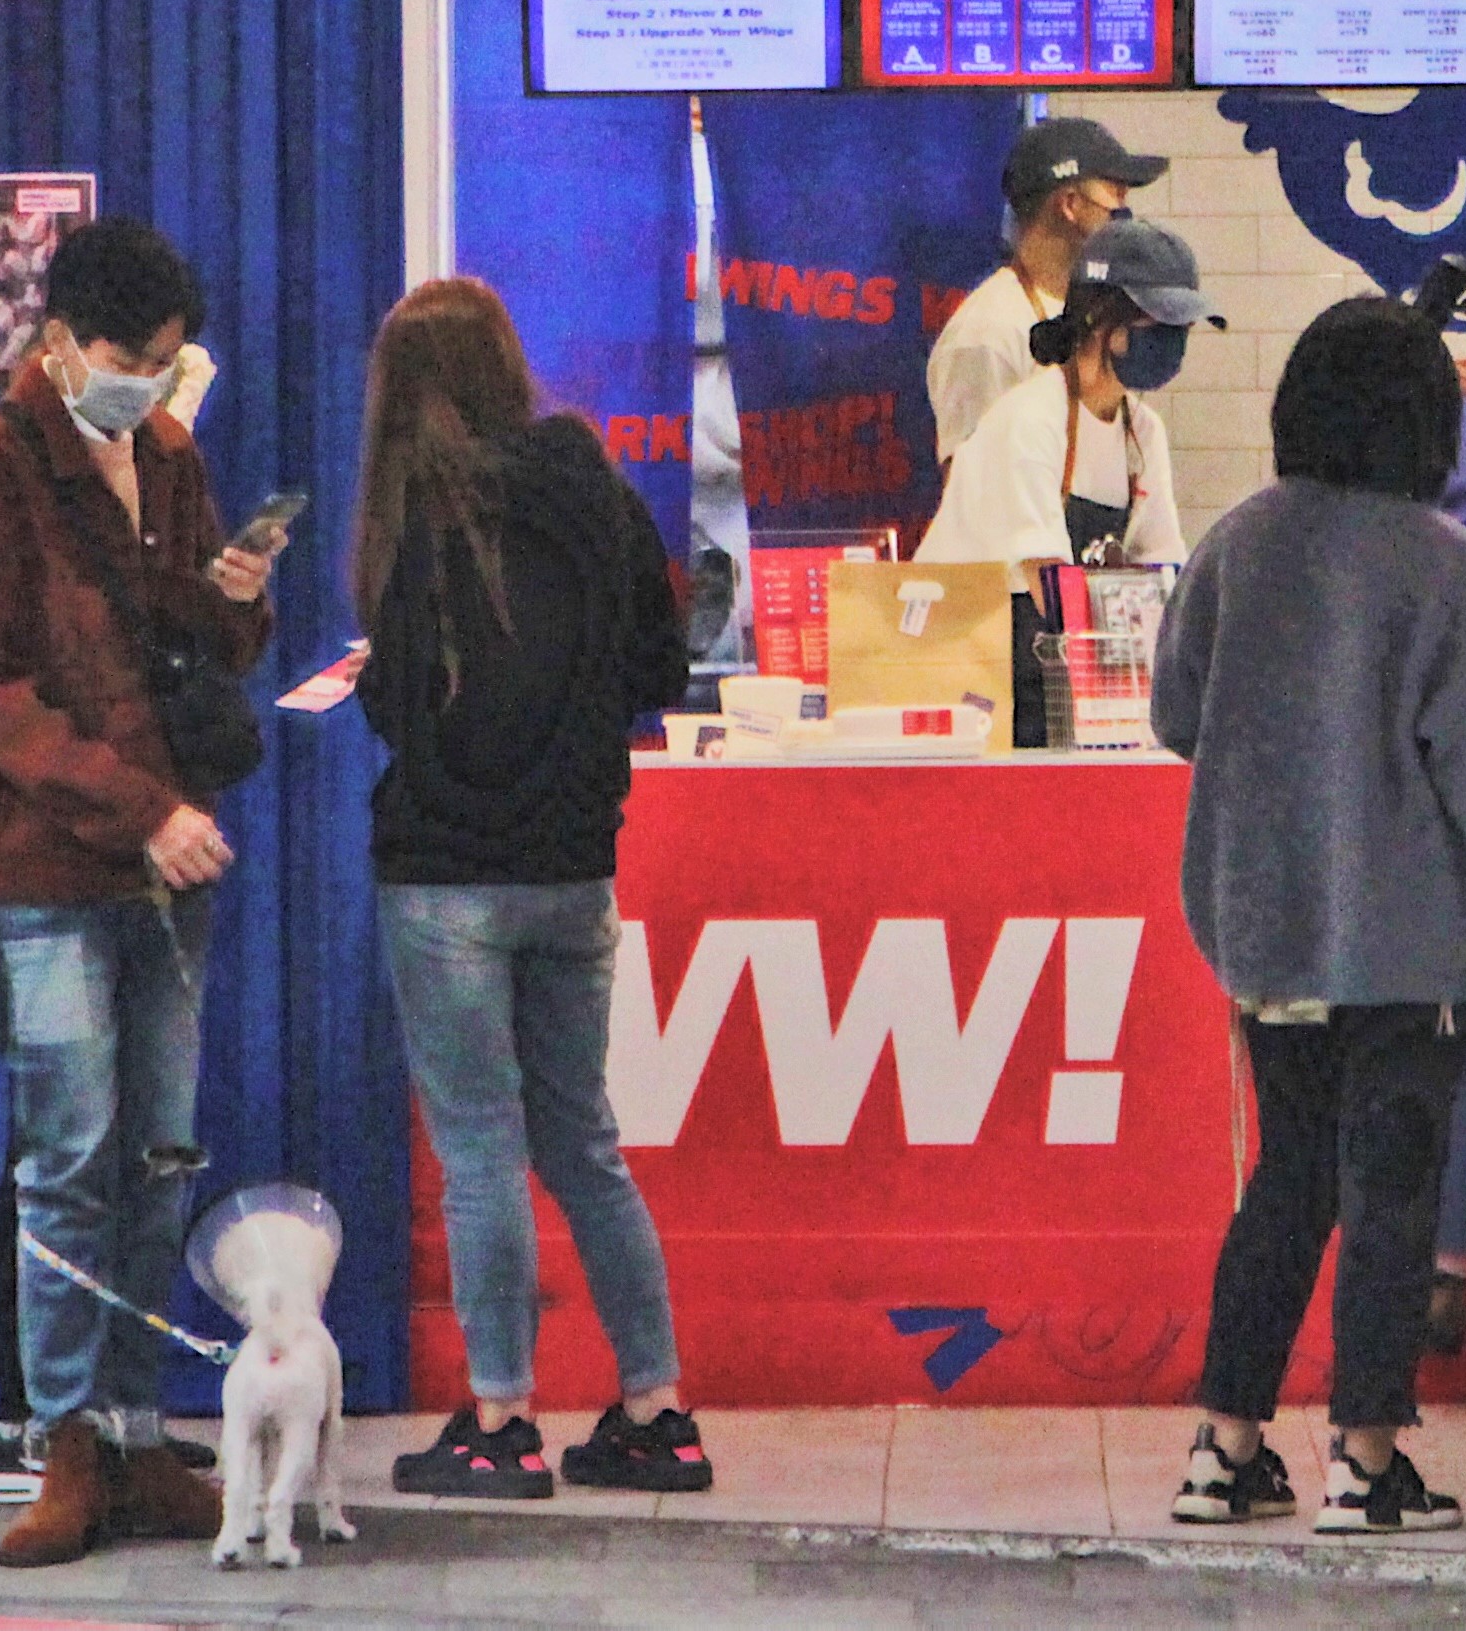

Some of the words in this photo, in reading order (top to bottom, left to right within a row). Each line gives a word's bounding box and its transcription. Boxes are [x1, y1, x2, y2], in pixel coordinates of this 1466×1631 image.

[607, 9, 640, 20] Step
[670, 9, 715, 18] Flavor
[738, 8, 762, 19] Dip
[577, 29, 610, 39] Step
[640, 28, 705, 39] Upgrade
[748, 27, 793, 38] Wings
[905, 45, 922, 64] A
[975, 45, 991, 63] B
[1042, 44, 1061, 63] C
[1113, 44, 1131, 63] D
